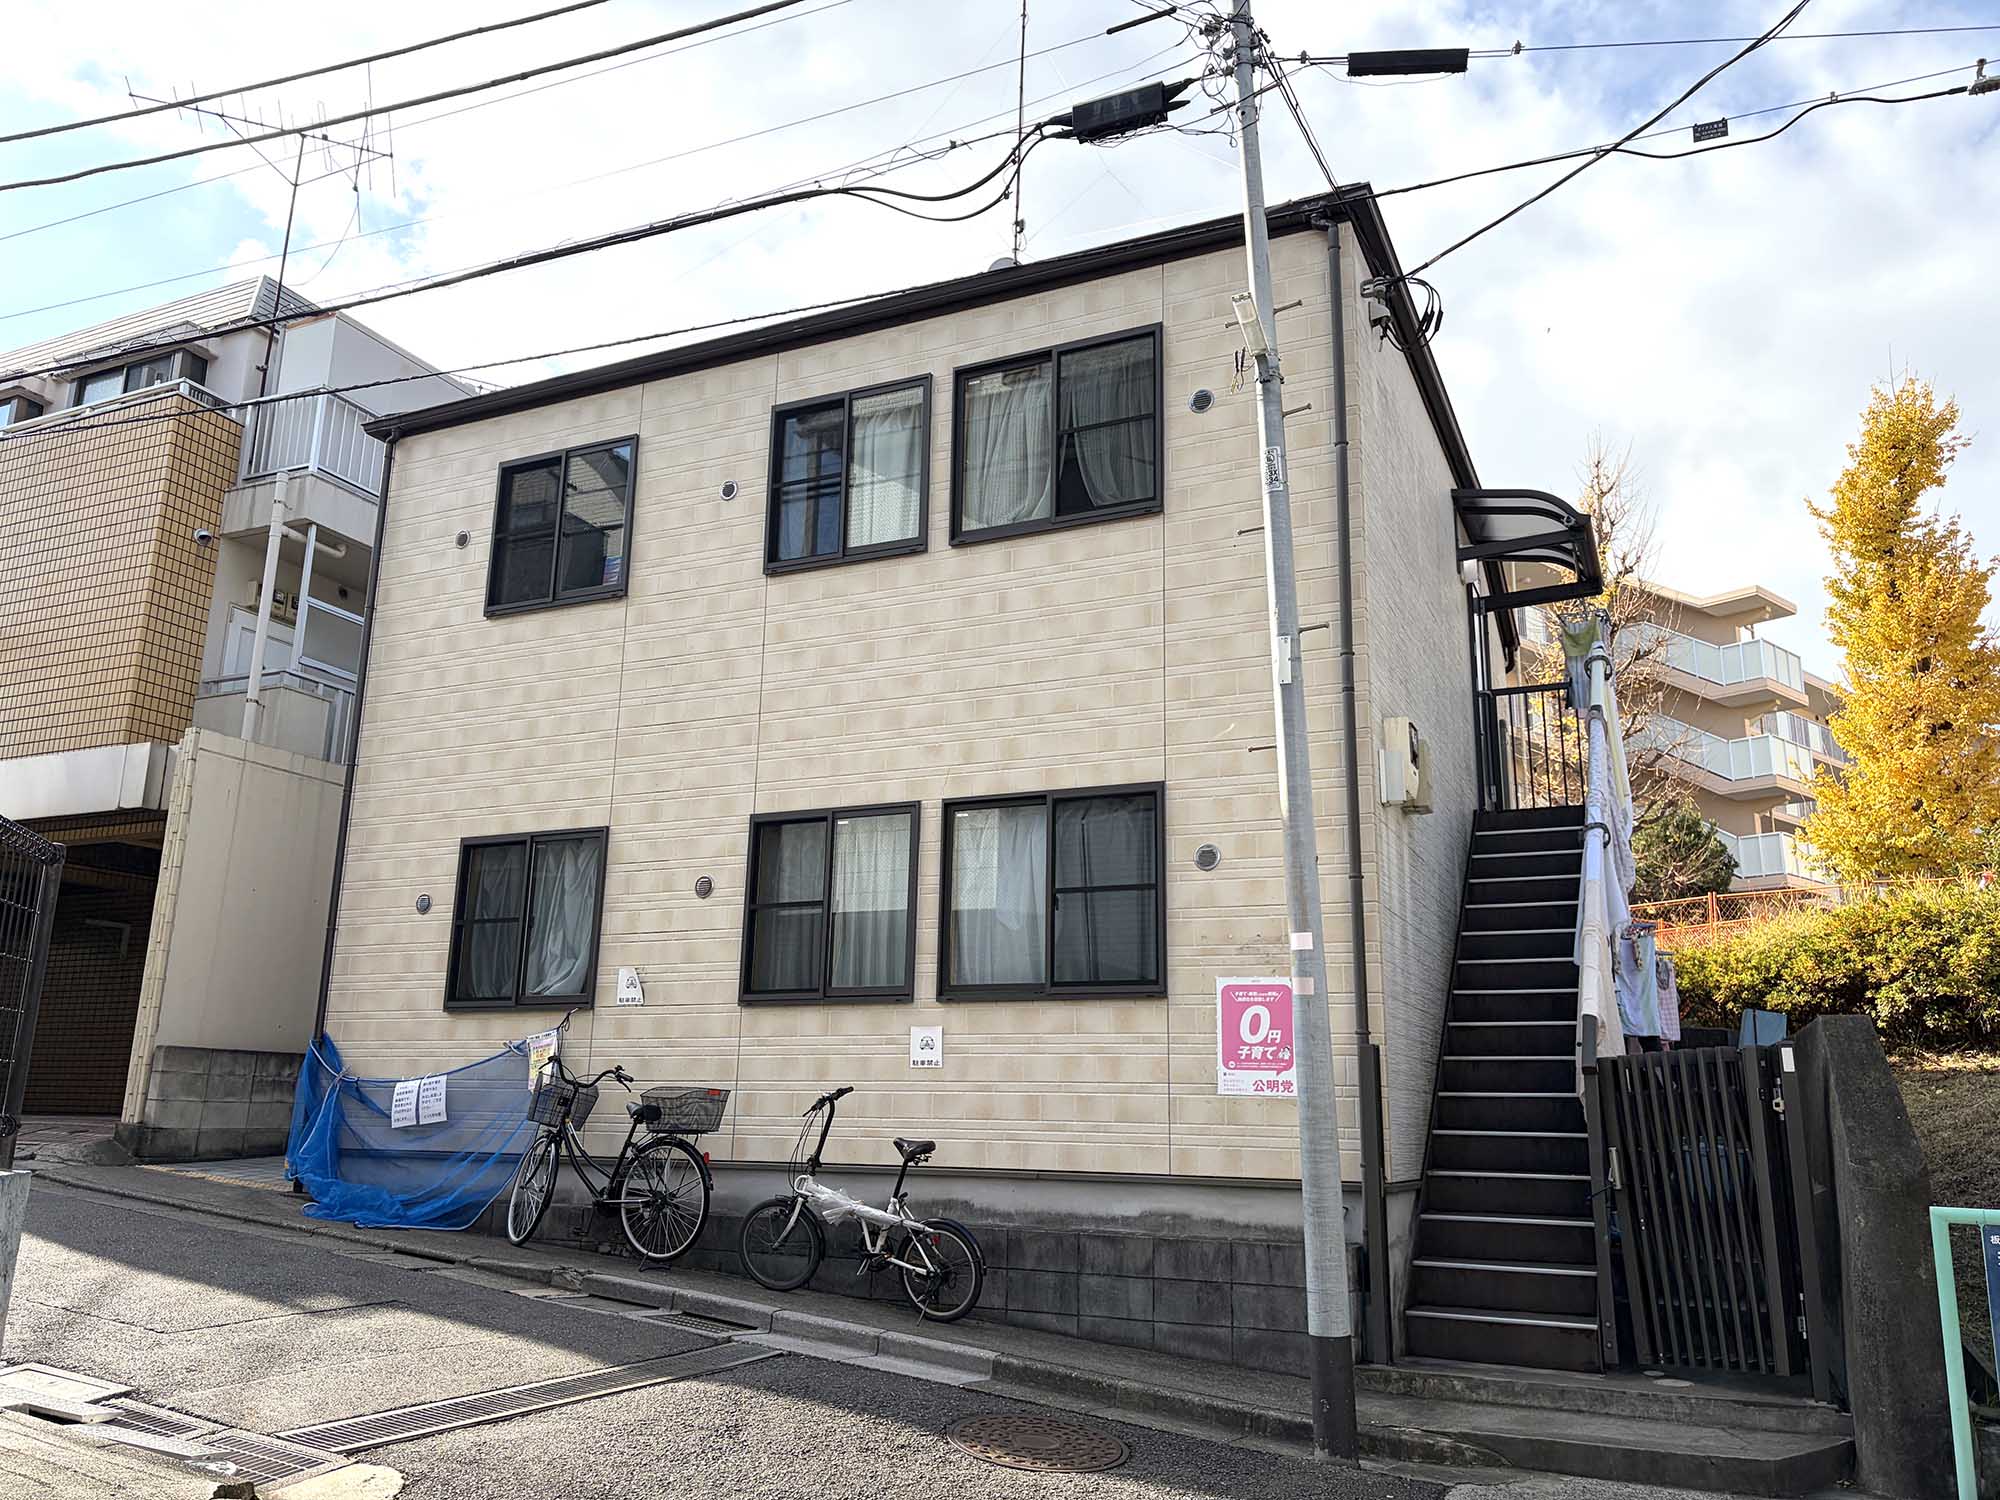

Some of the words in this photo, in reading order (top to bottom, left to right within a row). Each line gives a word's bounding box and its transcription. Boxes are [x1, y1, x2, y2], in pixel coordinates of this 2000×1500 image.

[1237, 1045, 1277, 1060] 子育て
[1252, 1079, 1294, 1093] 公明党
